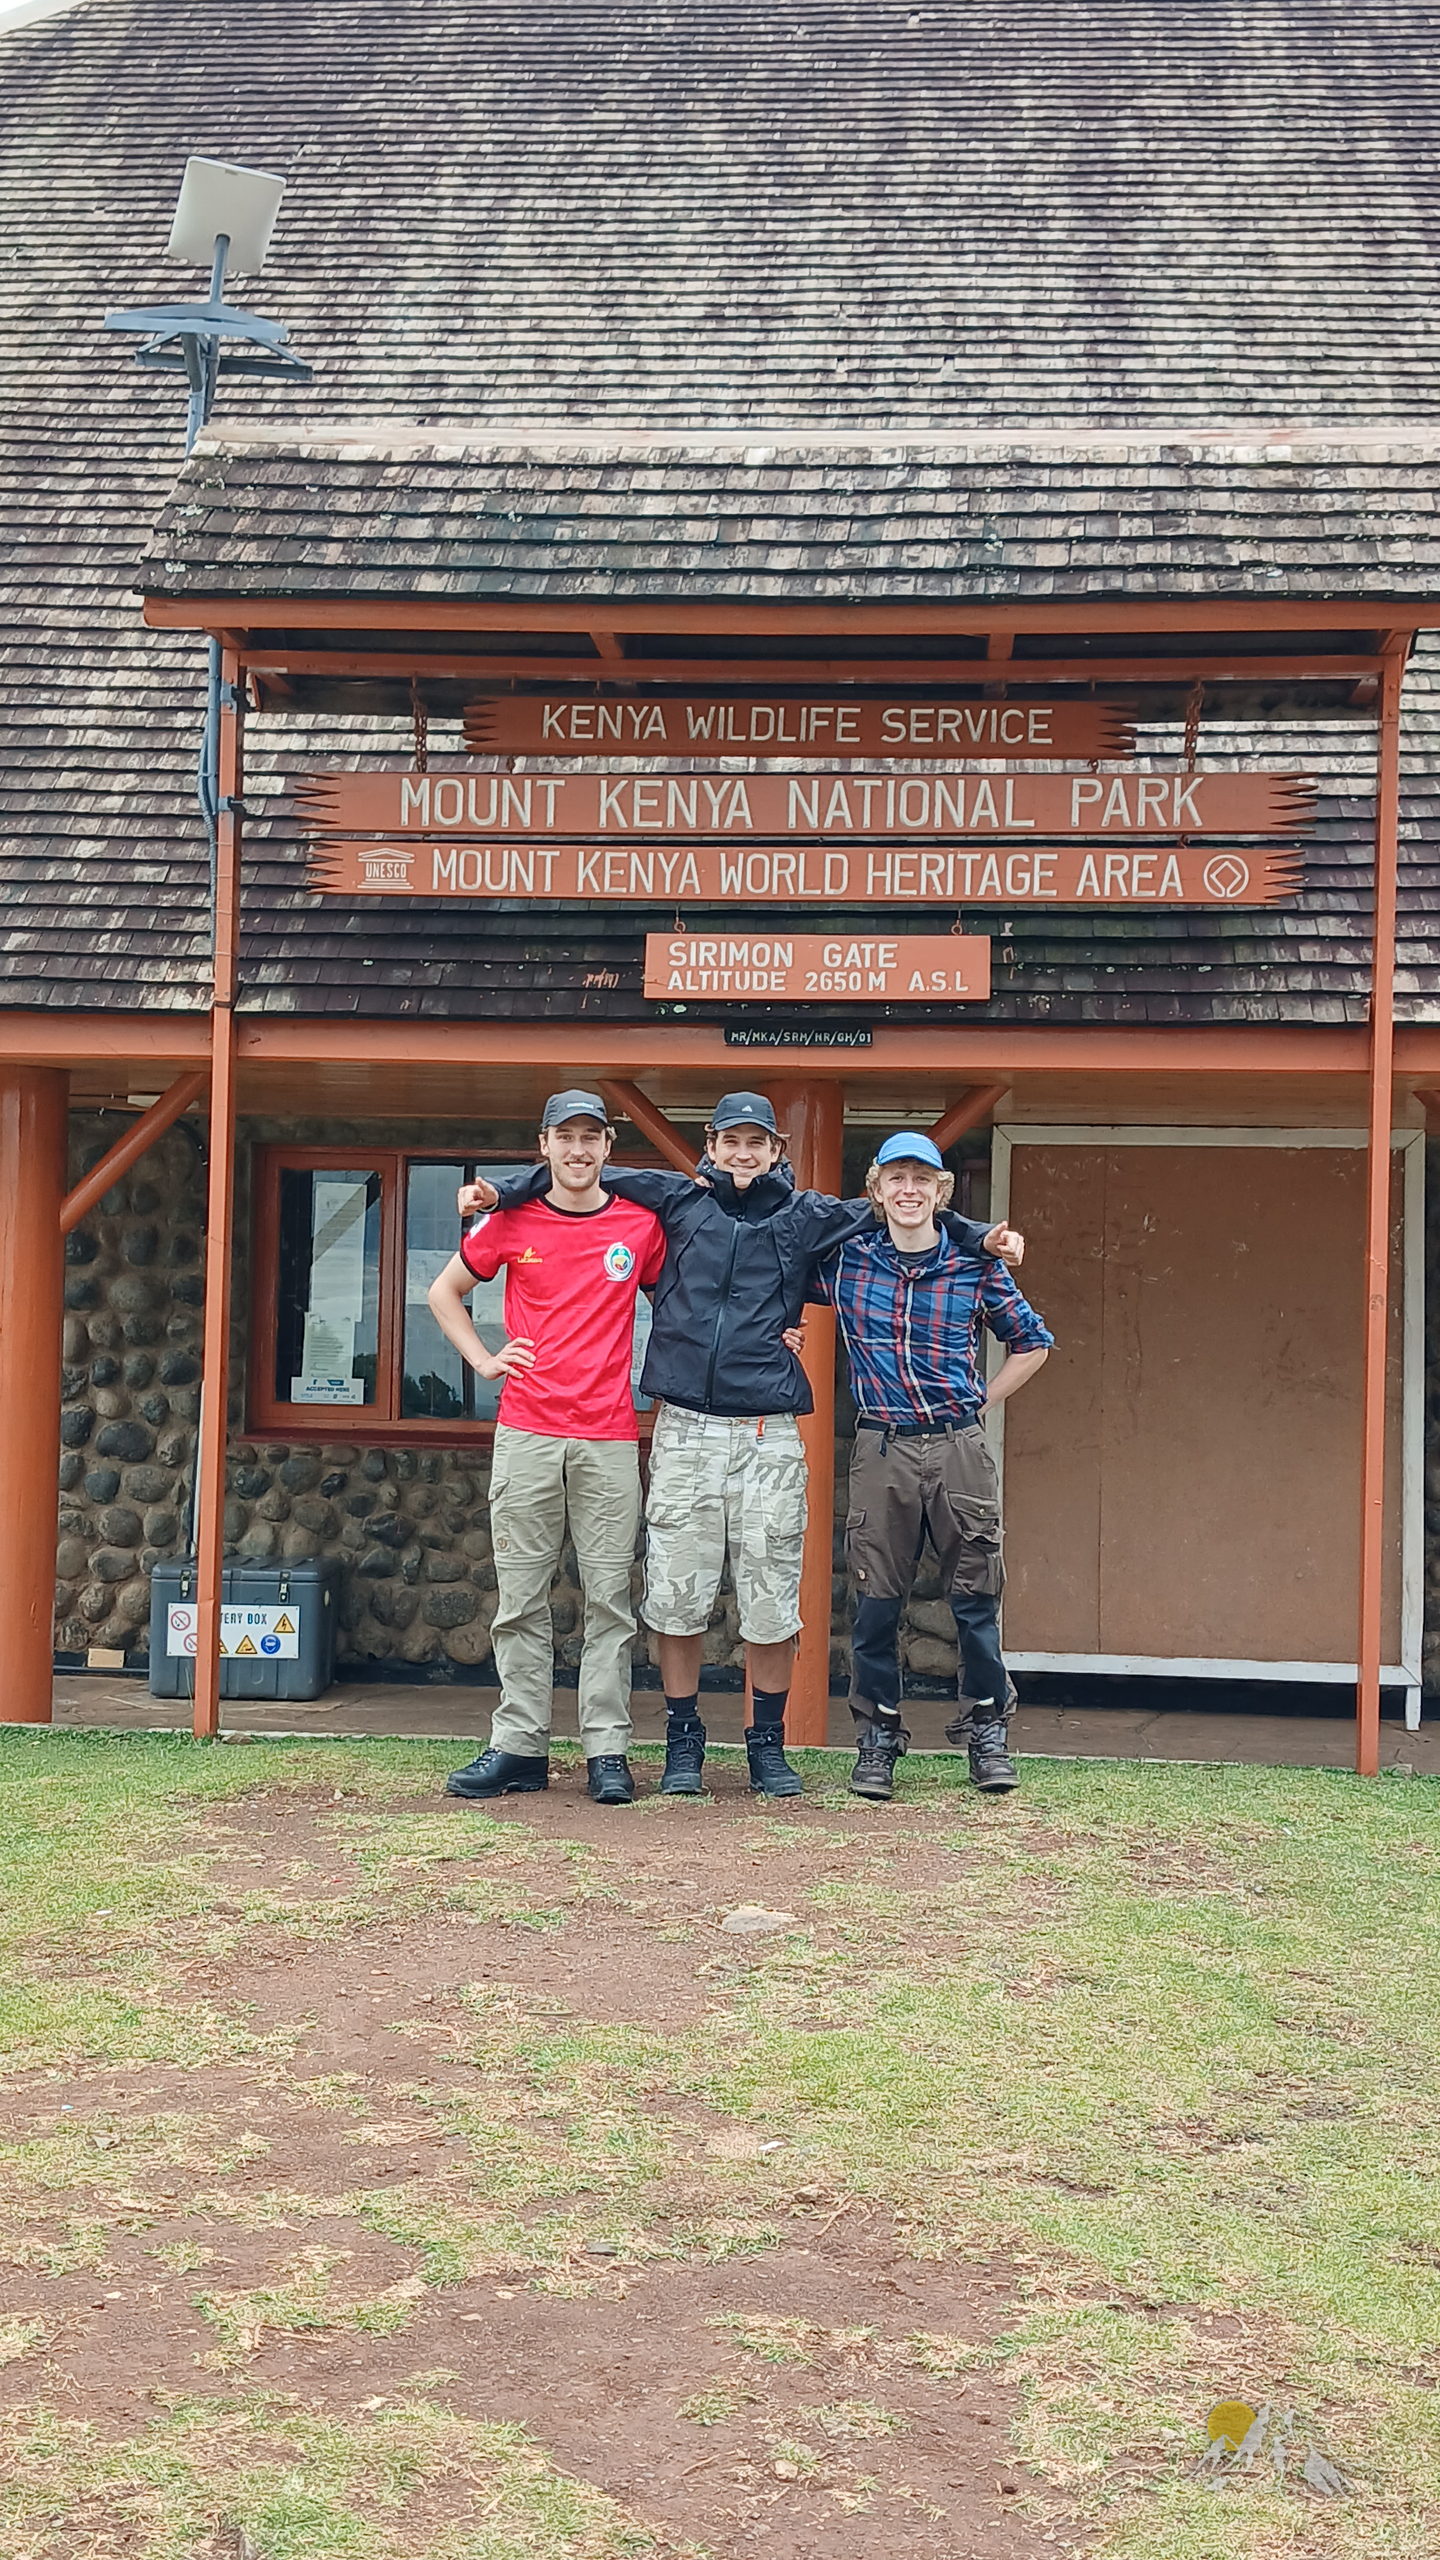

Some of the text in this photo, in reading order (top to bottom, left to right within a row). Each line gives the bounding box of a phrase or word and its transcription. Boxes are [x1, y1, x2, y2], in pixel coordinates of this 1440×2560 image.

[542, 704, 1053, 745] KENYA WILDLIFE SERVICE
[400, 777, 1204, 830] MOUNT KENYA NATIONAL PARK
[365, 862, 407, 879] UNESCO
[432, 848, 1184, 897] MOUNT KENYA WORLD HERITAGE AREA
[668, 941, 898, 969] SIRIMON GATE
[667, 970, 787, 991] ALTITUDE
[804, 971, 861, 992] 2650
[868, 971, 886, 991] M
[247, 1613, 267, 1625] BOX
